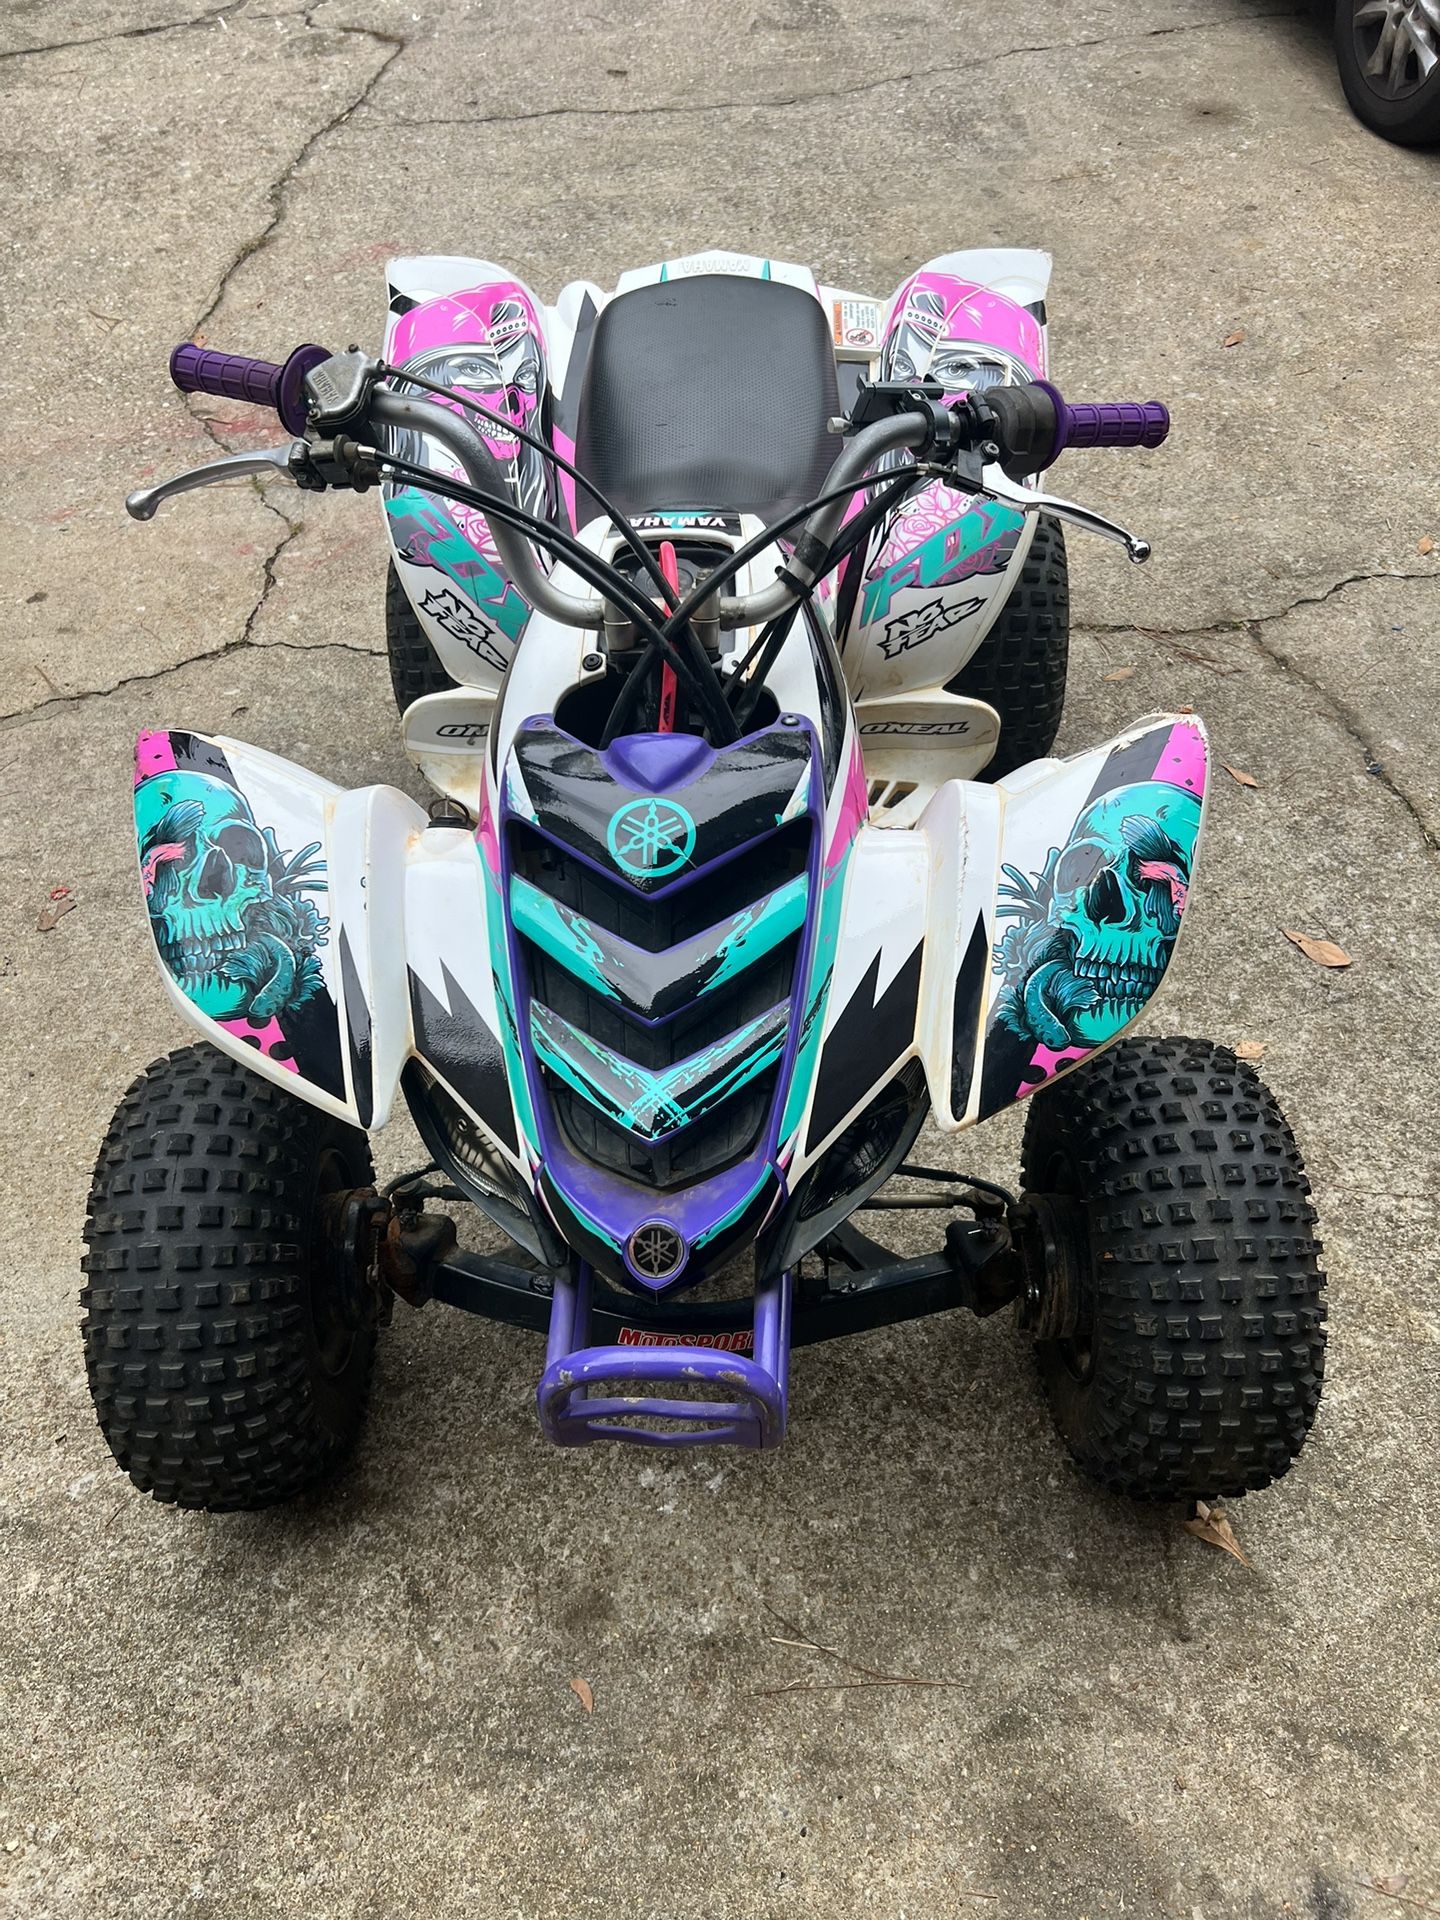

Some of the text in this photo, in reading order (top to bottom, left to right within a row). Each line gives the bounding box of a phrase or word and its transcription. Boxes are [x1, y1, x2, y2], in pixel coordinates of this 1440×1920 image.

[681, 259, 750, 273] YAMAHA
[629, 516, 727, 528] YAMAHA
[859, 500, 1025, 630] FOX
[417, 589, 509, 673] FEAR
[432, 588, 496, 640] NO
[876, 597, 989, 661] FEAR
[884, 596, 944, 642] NO
[617, 1326, 754, 1351] MOTOSPOR
